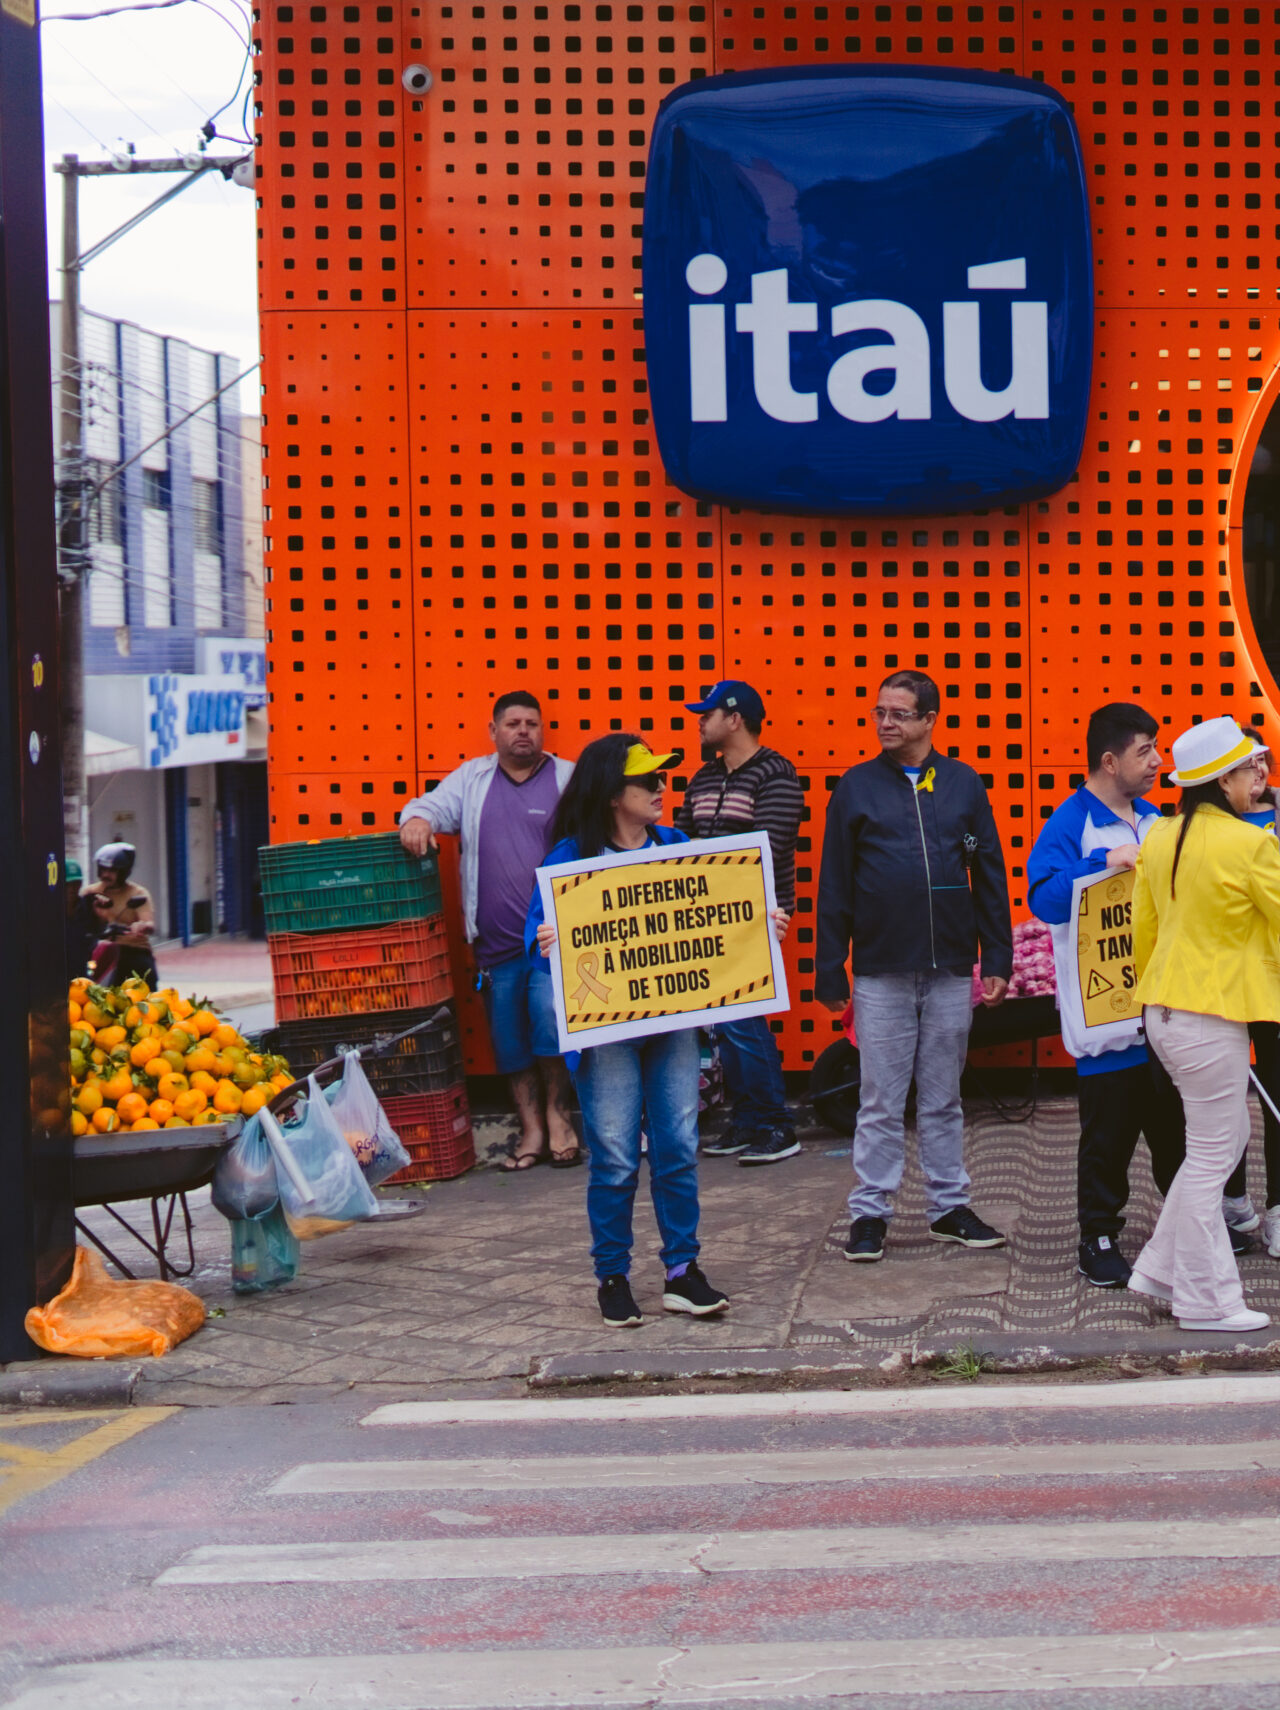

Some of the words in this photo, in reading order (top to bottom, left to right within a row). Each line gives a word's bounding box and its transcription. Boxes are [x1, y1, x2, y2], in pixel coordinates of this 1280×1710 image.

[685, 253, 1050, 423] itaú
[602, 889, 613, 912] A
[617, 875, 709, 909] DIFERENÇA
[571, 916, 640, 949] COMEÇA
[645, 912, 668, 936] NO
[674, 900, 754, 931] RESPEITO
[603, 948, 615, 974] À
[619, 935, 725, 972] MOBILIDADE
[628, 979, 650, 1002] DE
[654, 968, 710, 997] TODOS
